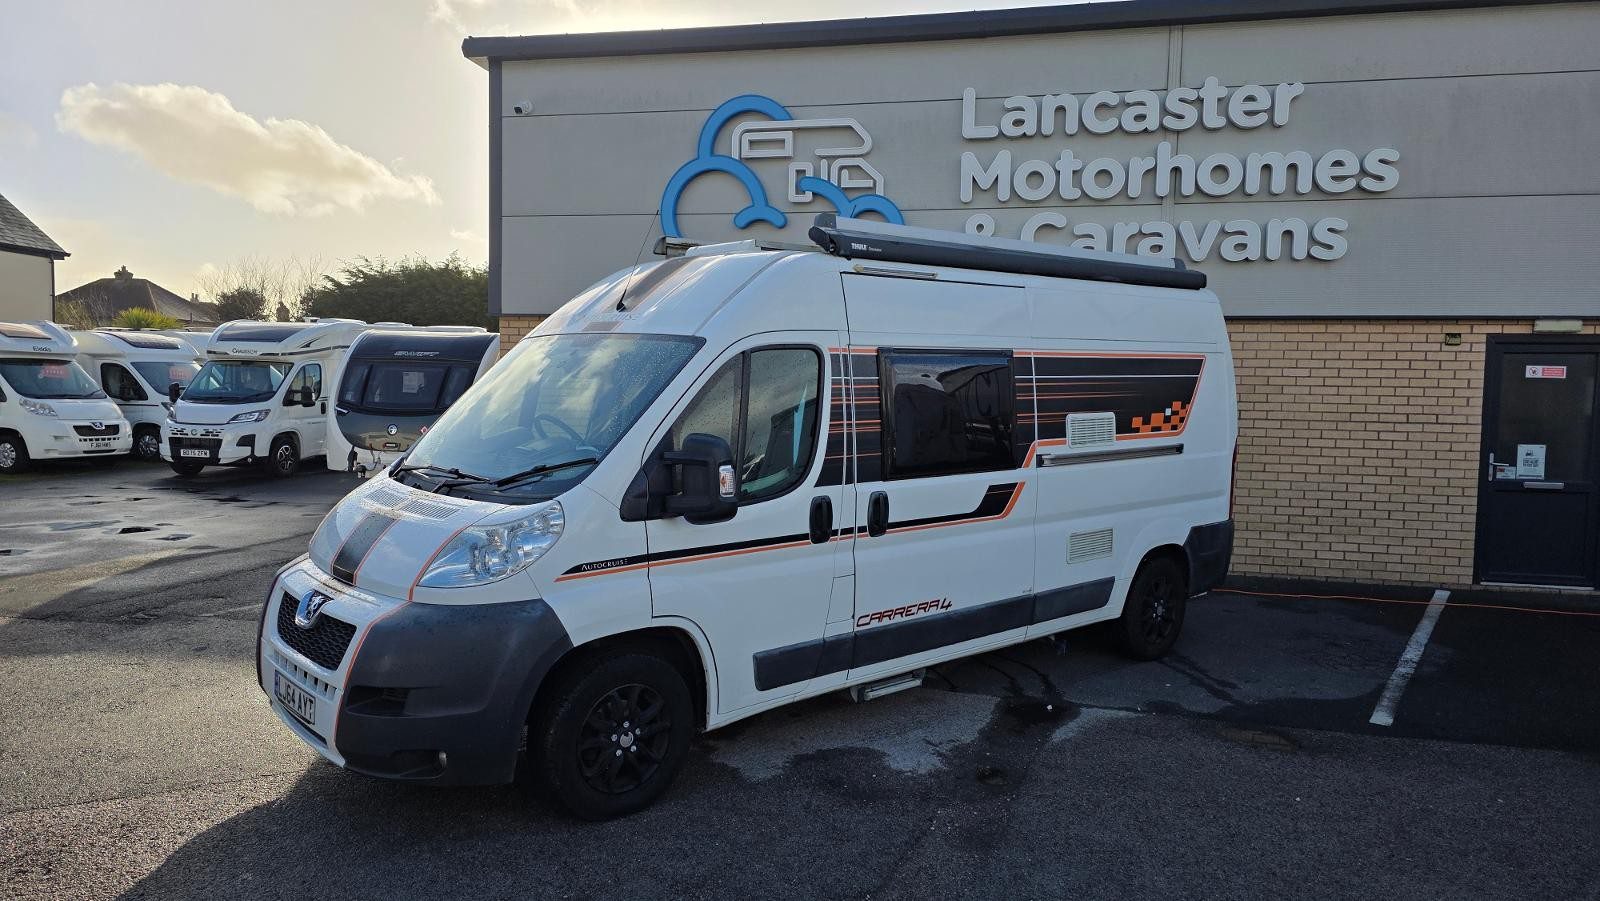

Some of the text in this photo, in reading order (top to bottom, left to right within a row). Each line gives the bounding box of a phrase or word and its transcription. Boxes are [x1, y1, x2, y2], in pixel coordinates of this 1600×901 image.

[961, 76, 1304, 140] Lancaster
[960, 141, 1400, 203] Motorhomes
[581, 558, 628, 571] AUTOCRUISE
